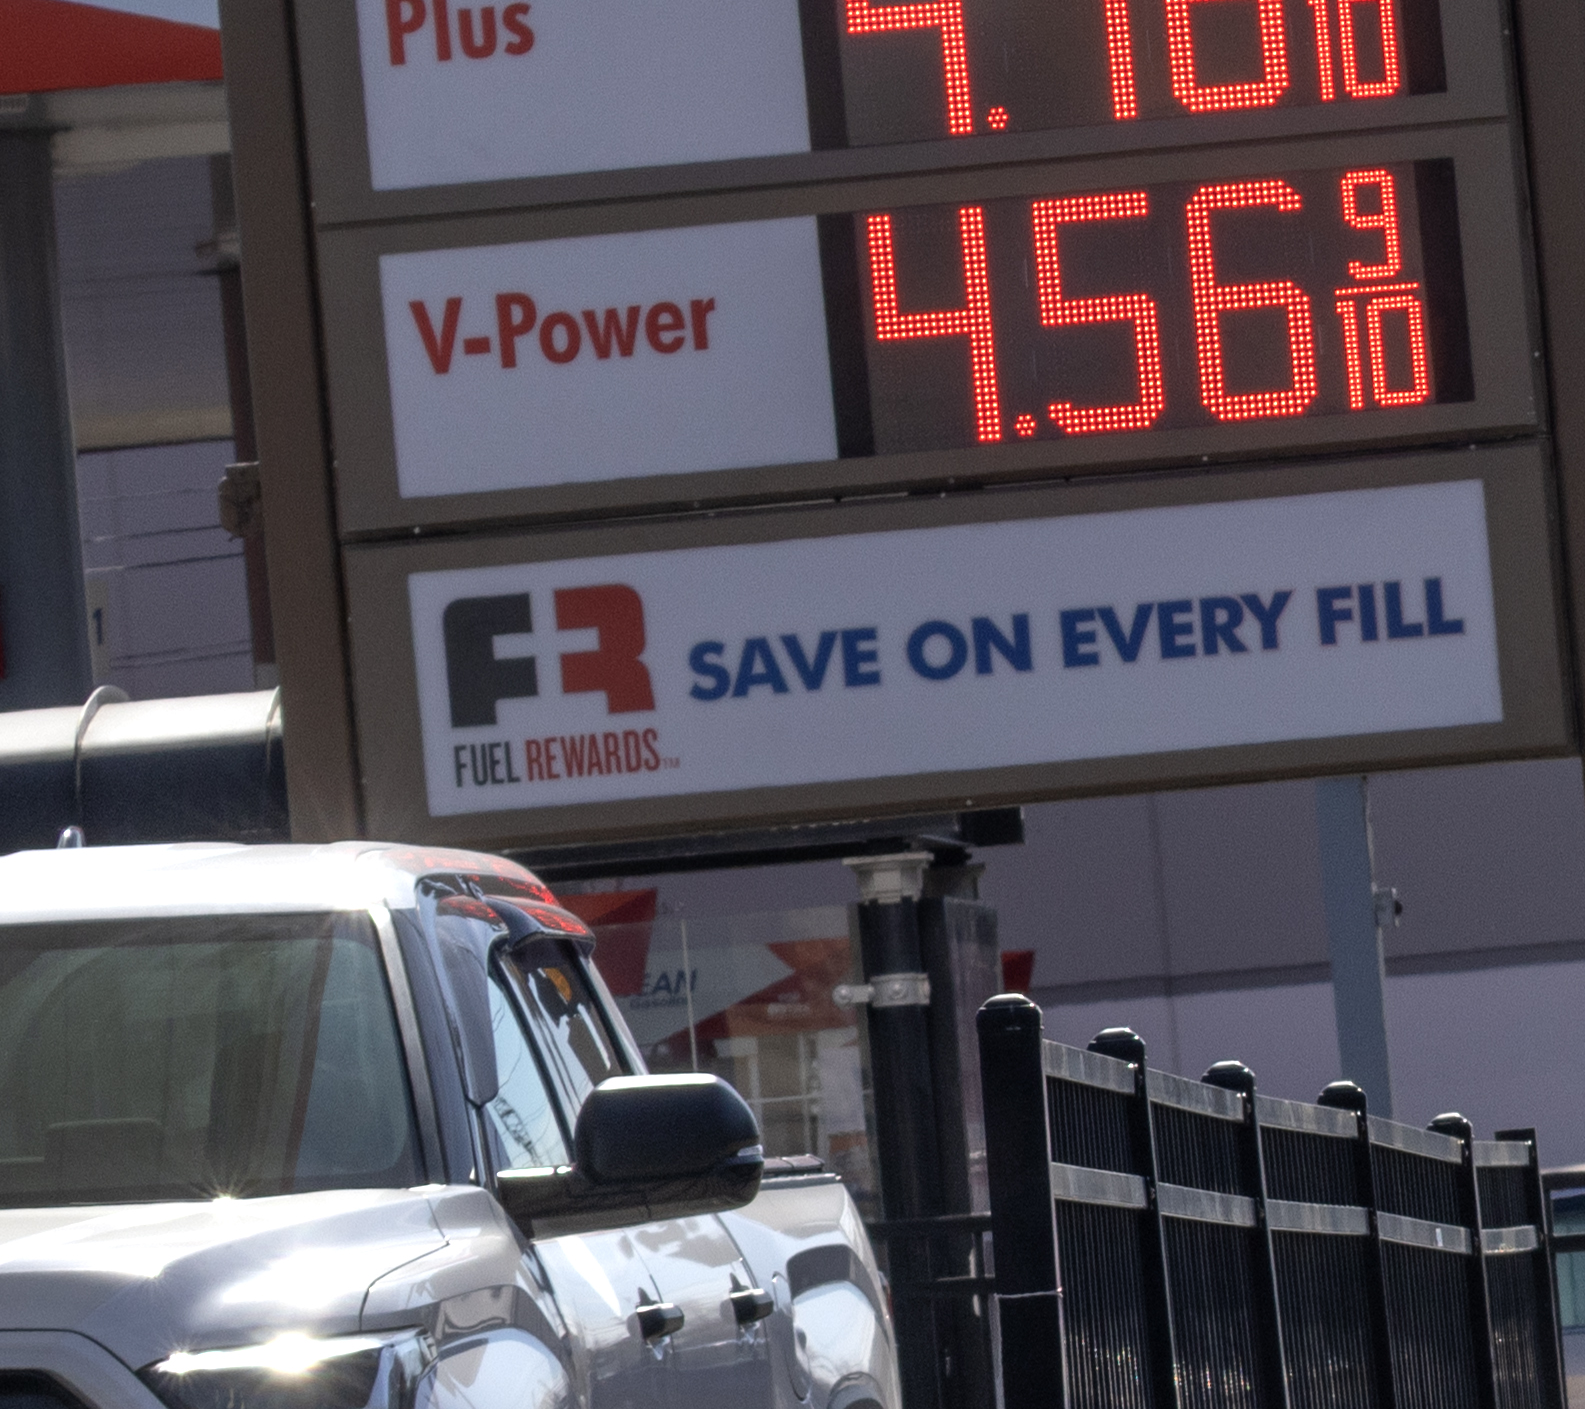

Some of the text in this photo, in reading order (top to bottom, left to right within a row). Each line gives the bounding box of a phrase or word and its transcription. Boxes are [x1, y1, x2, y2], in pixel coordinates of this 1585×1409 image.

[409, 293, 716, 376] V-Power
[686, 576, 1465, 703] SAVE ON EVERY FILL
[454, 727, 663, 789] FUEL REWARDS
